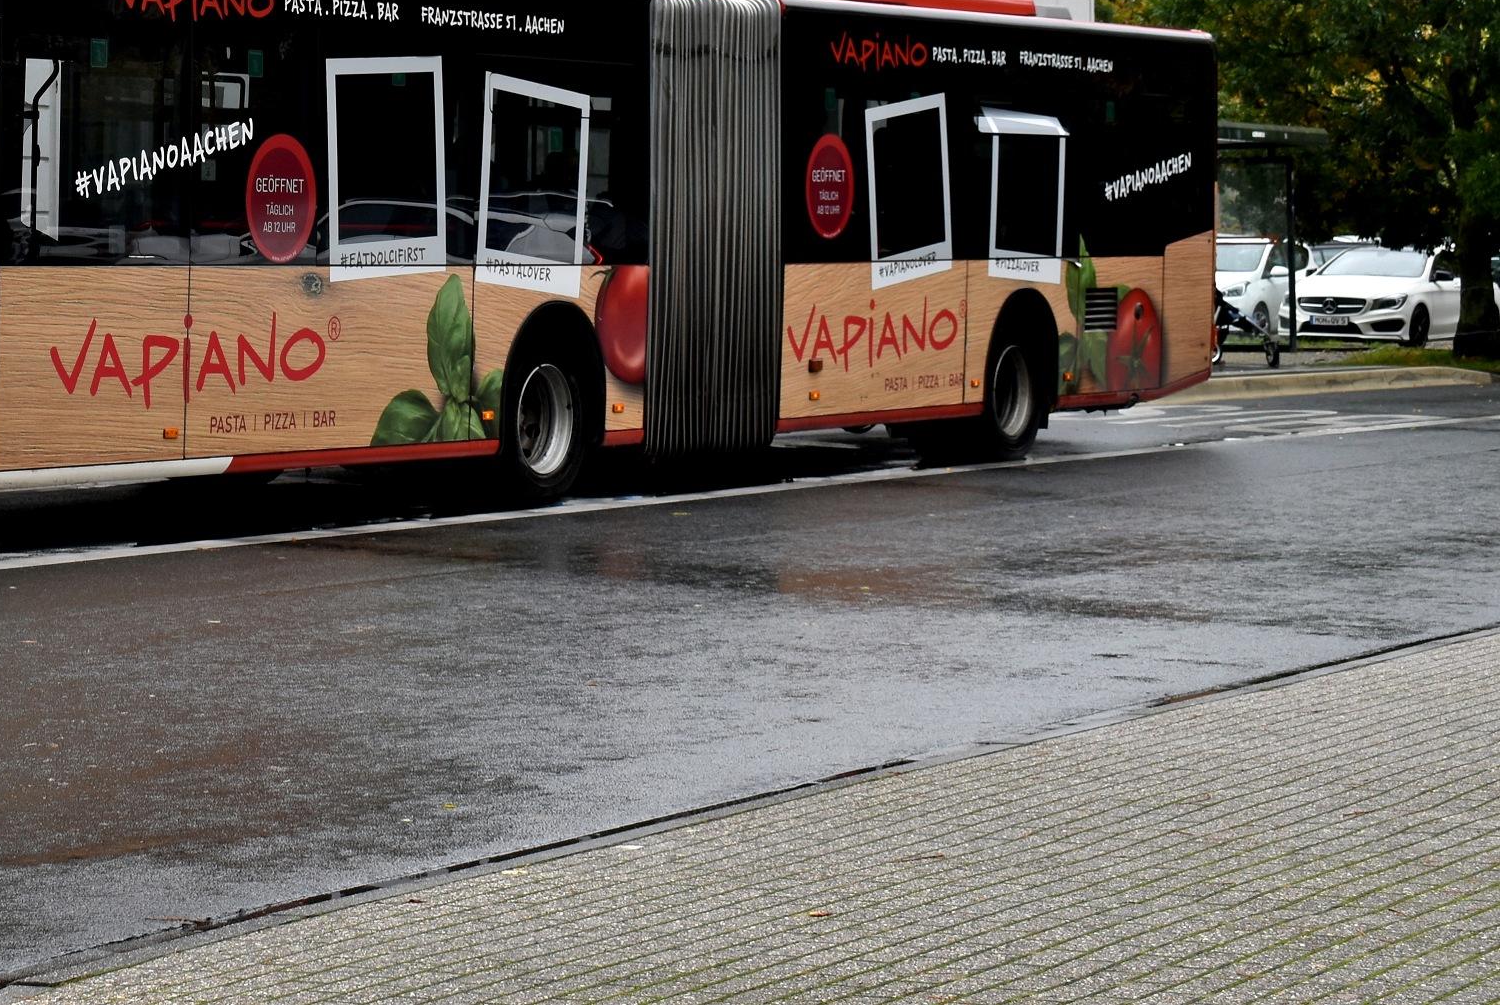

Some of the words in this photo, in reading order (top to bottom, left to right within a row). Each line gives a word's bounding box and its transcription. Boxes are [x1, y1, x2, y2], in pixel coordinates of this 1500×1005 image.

[377, 2, 399, 22] BAR
[421, 6, 503, 30] FRANZSTRASSE
[525, 15, 565, 35] AACHEN
[963, 49, 986, 65] PIZZA
[992, 50, 1006, 66] BAR
[1019, 52, 1073, 70] FRANZSTRASSE
[1087, 56, 1113, 73] AACHEN
[75, 118, 253, 198] #VAPIANOAACHEN
[255, 174, 305, 194] GEÖFFNET
[812, 167, 846, 183] GEÖFFNET
[1104, 151, 1192, 202] #VAPIANOAACHEN
[819, 189, 839, 201] TÄGLICH
[266, 202, 294, 216] TÄGLICH
[817, 205, 823, 215] AB
[830, 205, 840, 215] UHR
[263, 221, 273, 233] AB
[274, 221, 280, 233] 12
[281, 221, 295, 233] UHR
[340, 247, 426, 269] #EATDOLCIFIRST
[879, 251, 936, 277] #VAPIANOLOVER
[995, 258, 1040, 273] #PIZZALOVER
[486, 258, 551, 282] #PASTALOVER
[884, 377, 908, 392] PASTA
[918, 375, 940, 389] PIZZA
[949, 373, 964, 387] BAR
[209, 415, 247, 434] PASTA
[264, 412, 296, 431] PIZZA
[313, 410, 336, 428] BAR
